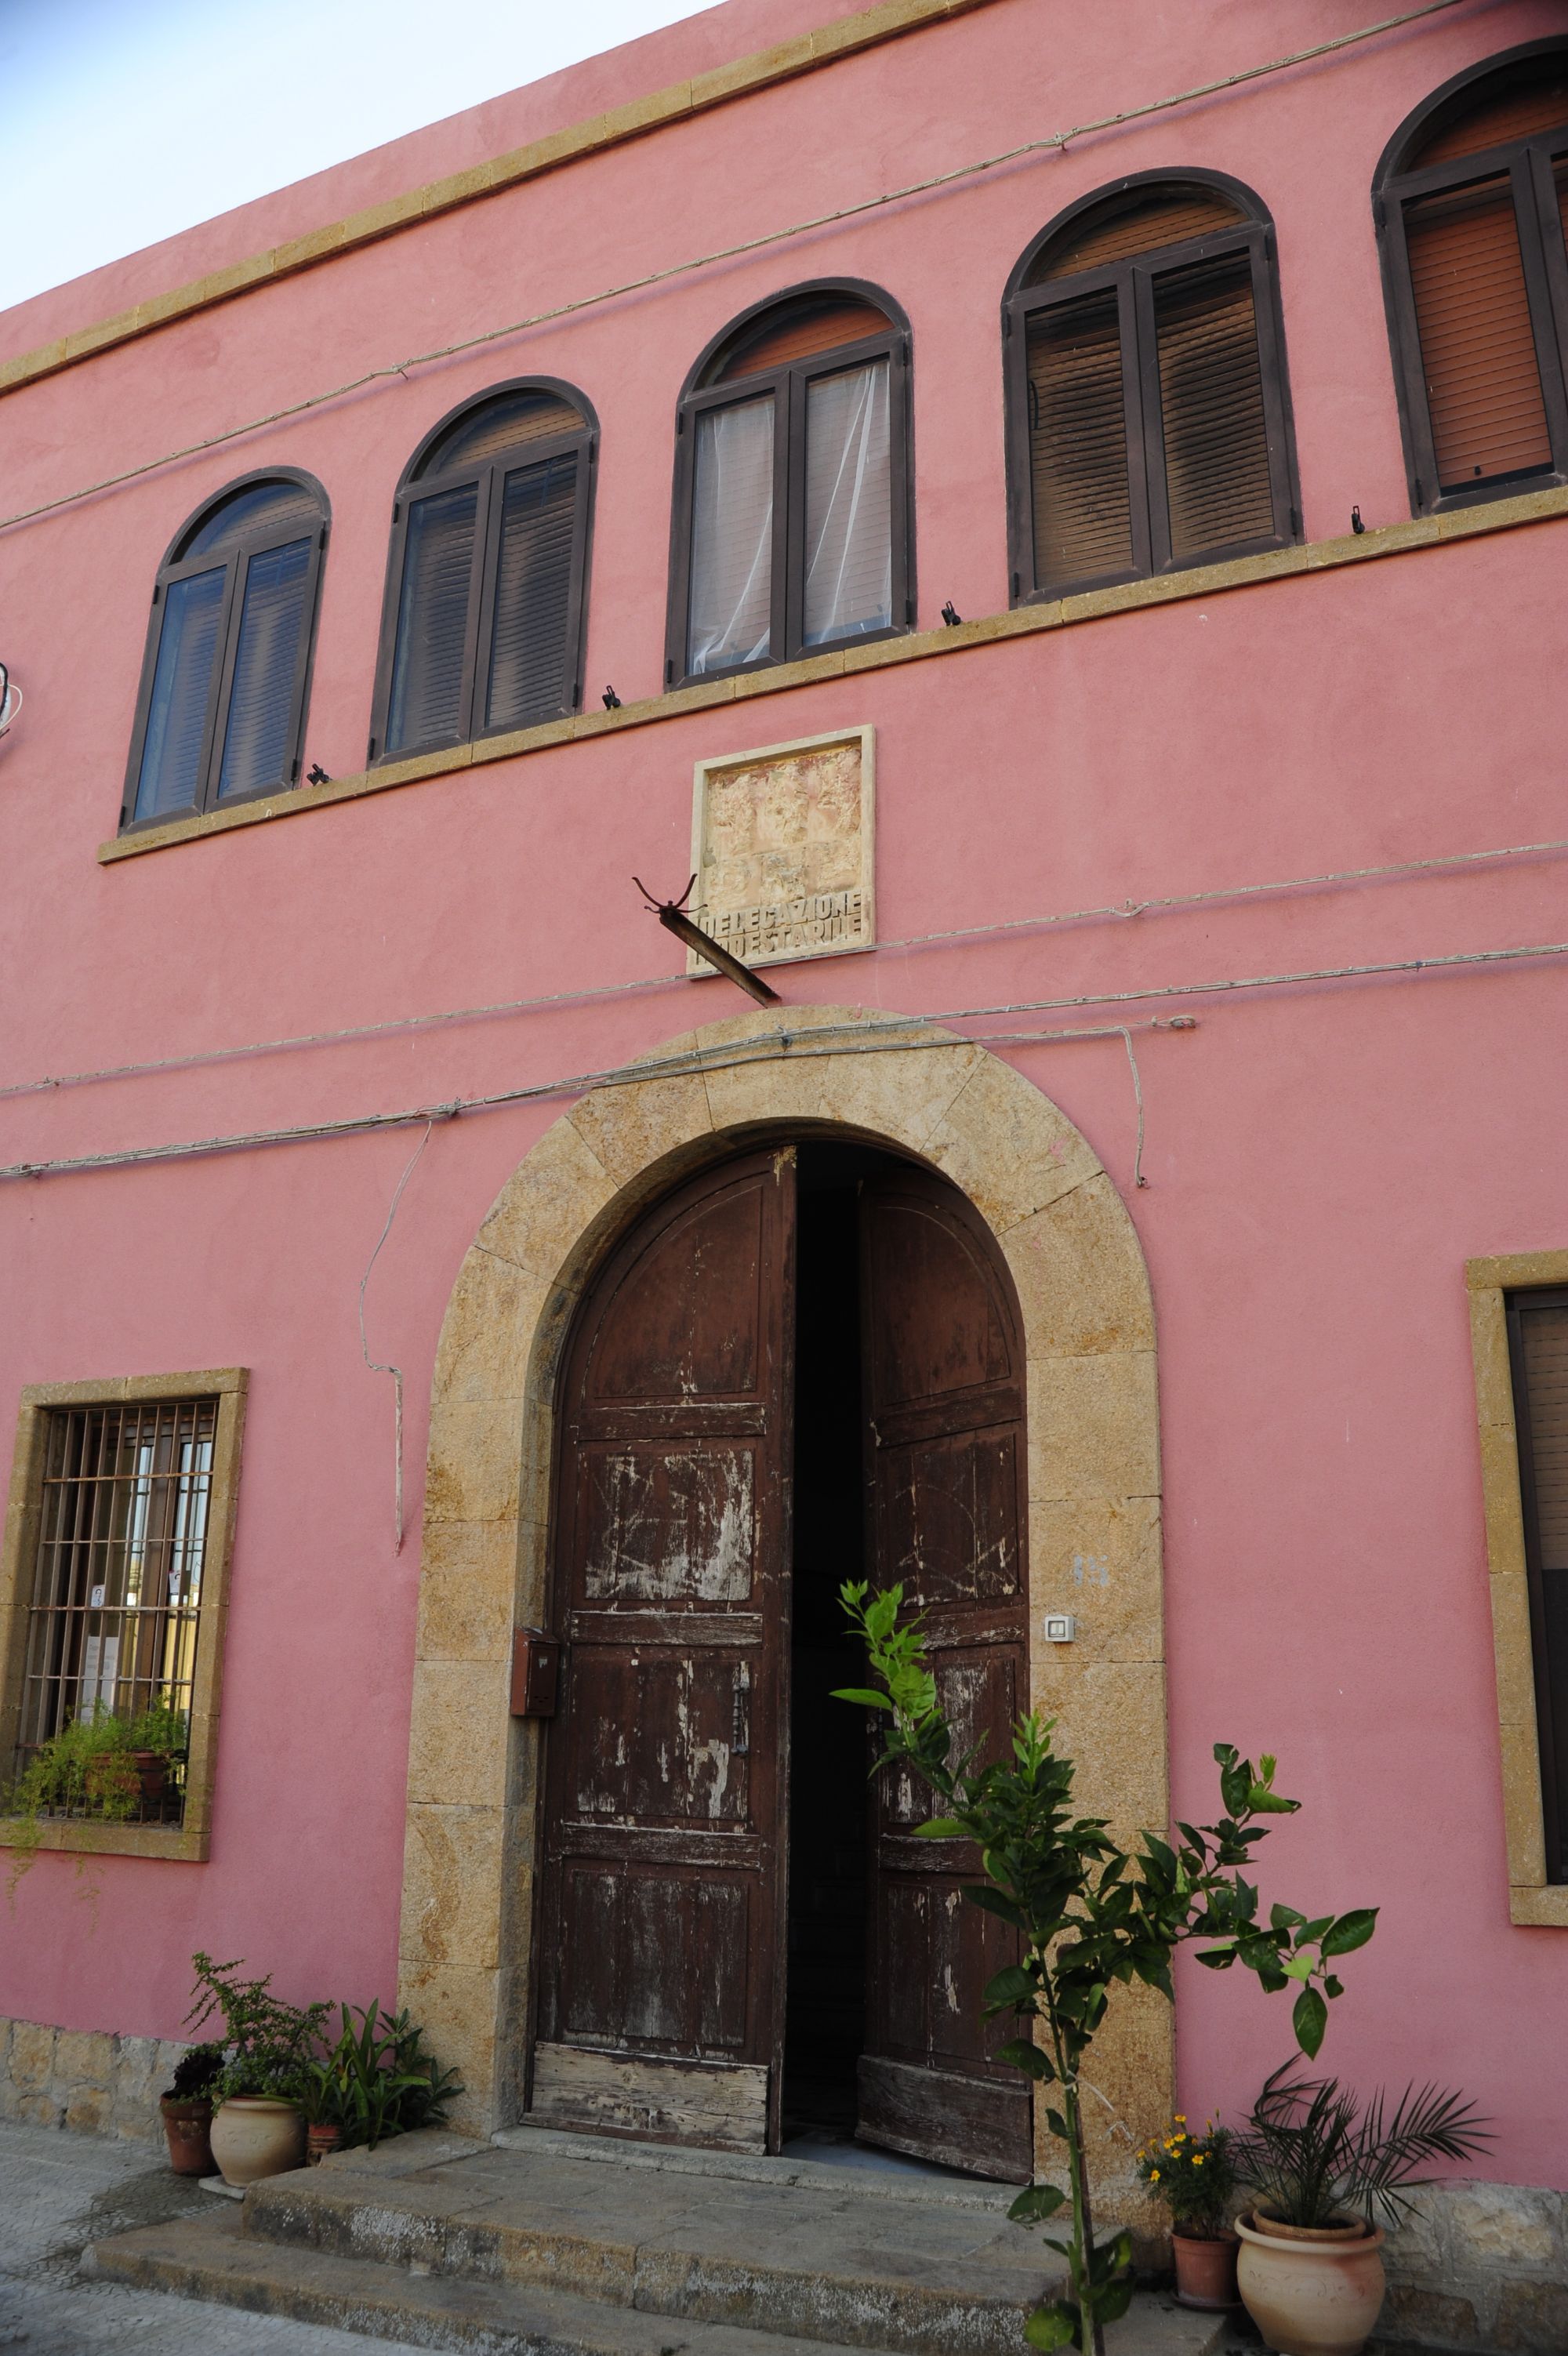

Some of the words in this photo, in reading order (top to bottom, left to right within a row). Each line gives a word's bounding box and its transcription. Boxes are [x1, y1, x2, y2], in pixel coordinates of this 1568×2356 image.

[699, 890, 862, 939] DELEGAZIONE
[698, 917, 862, 964] DESTARILE
[1073, 1555, 1109, 1587] 15
